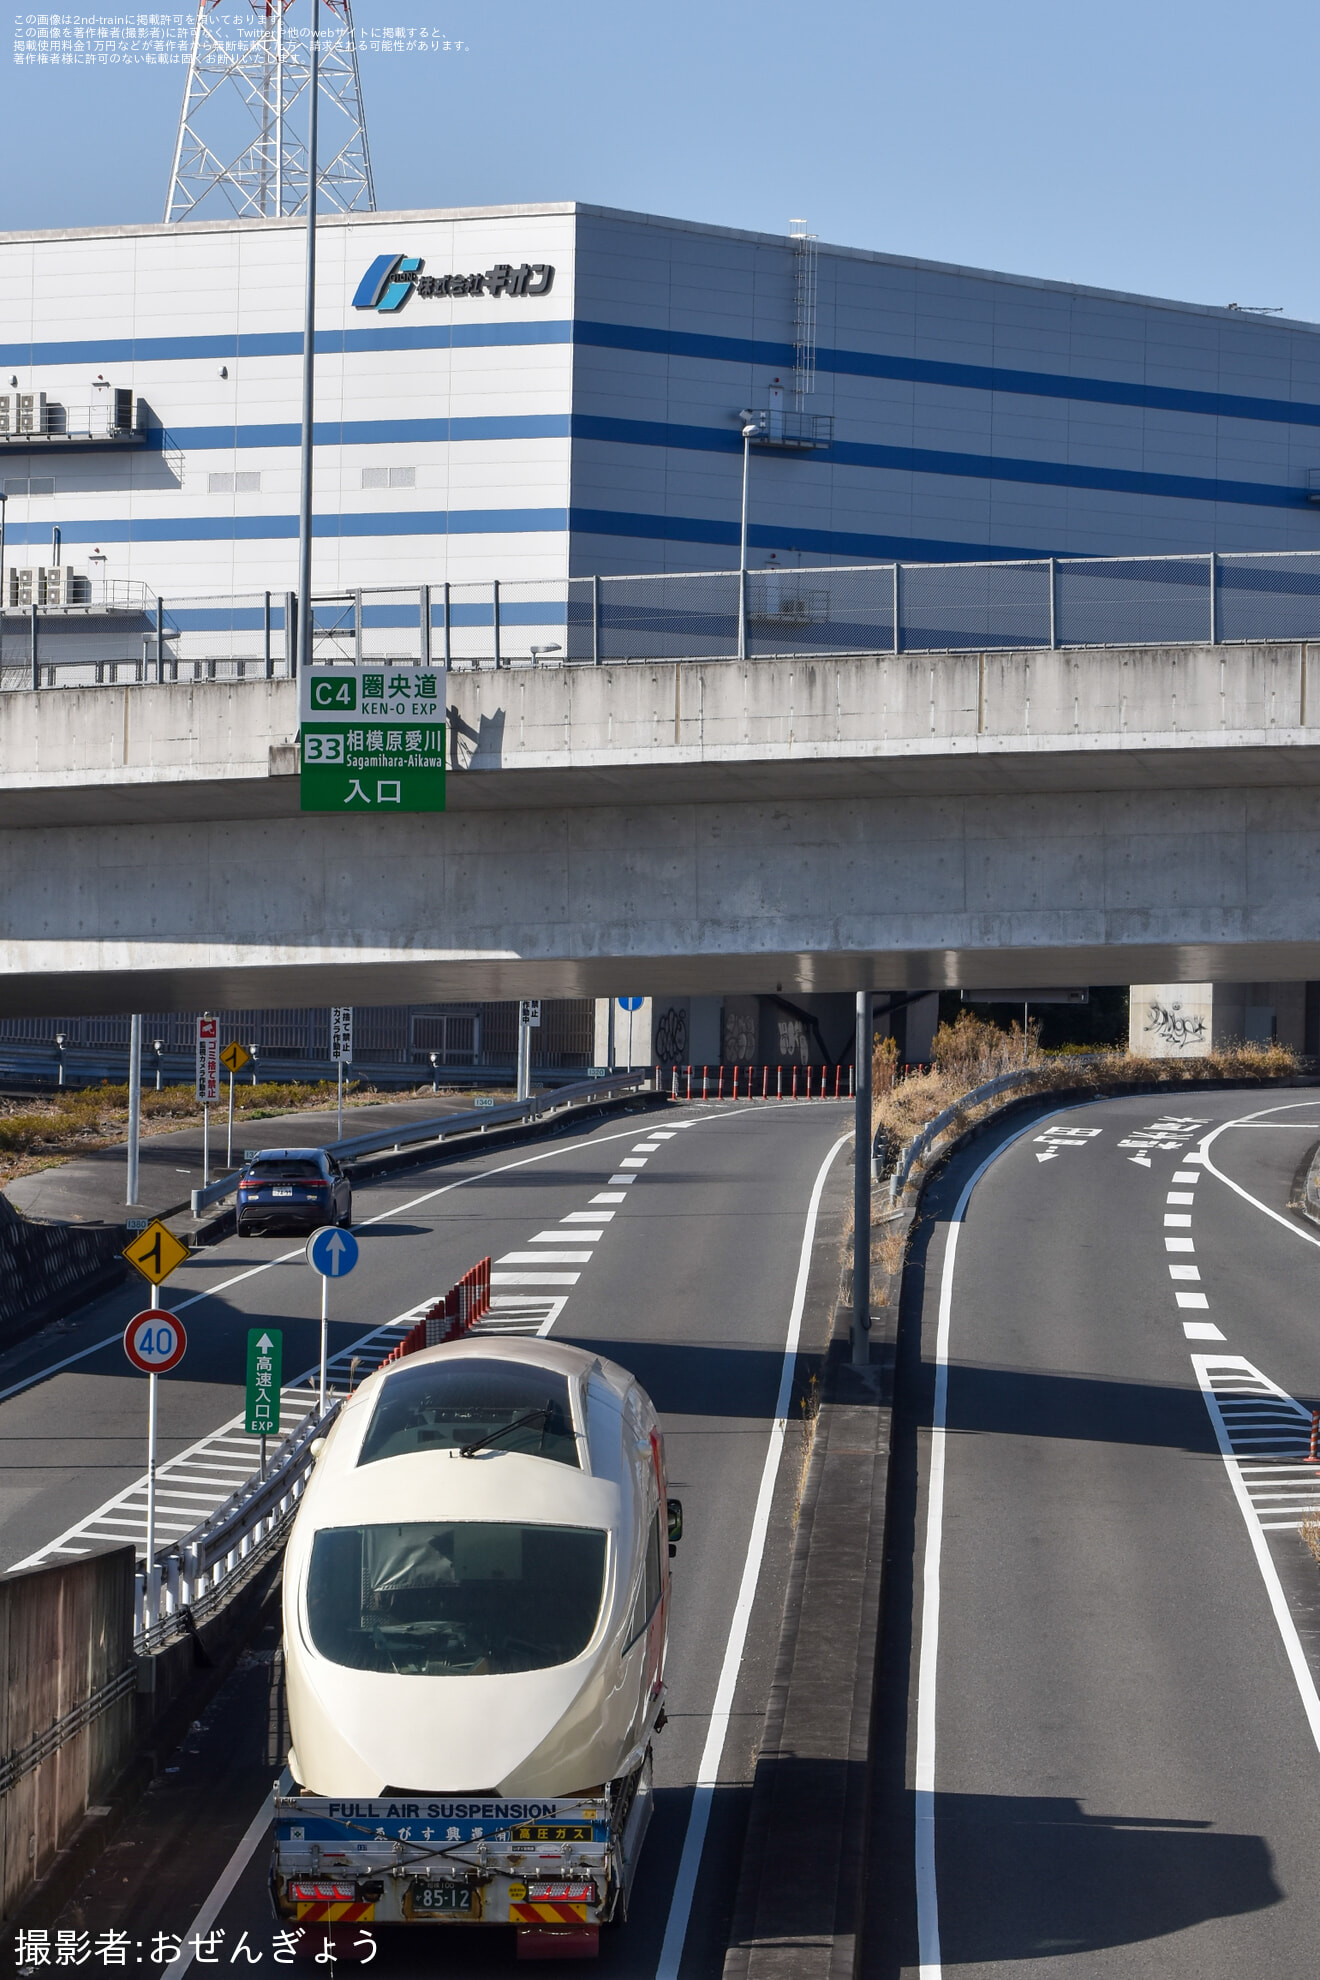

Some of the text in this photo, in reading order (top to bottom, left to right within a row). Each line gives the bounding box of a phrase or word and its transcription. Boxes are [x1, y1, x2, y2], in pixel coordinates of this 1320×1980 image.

[417, 263, 555, 298] 株式会社ギオン
[315, 682, 351, 705] C4
[361, 673, 438, 700] 圏央道
[362, 702, 437, 715] KEN-O EXP
[307, 738, 341, 760] 33
[346, 729, 441, 752] 相模原愛川
[346, 754, 442, 770] Sagamihara-Aikawa
[344, 778, 401, 803] 入口
[333, 1007, 341, 1059] カメラ作動中
[207, 1040, 217, 1098] ゴミ捨て禁止
[476, 1098, 493, 1106] 1340
[127, 1220, 147, 1229] 1380
[139, 1327, 172, 1355] 40
[255, 1355, 273, 1419] 高速入口
[250, 1420, 274, 1431] EXP
[329, 1803, 556, 1819] FULL AIR SUSPENSION
[519, 1828, 585, 1841] 高圧ガス
[423, 1889, 470, 1907] 85-12
